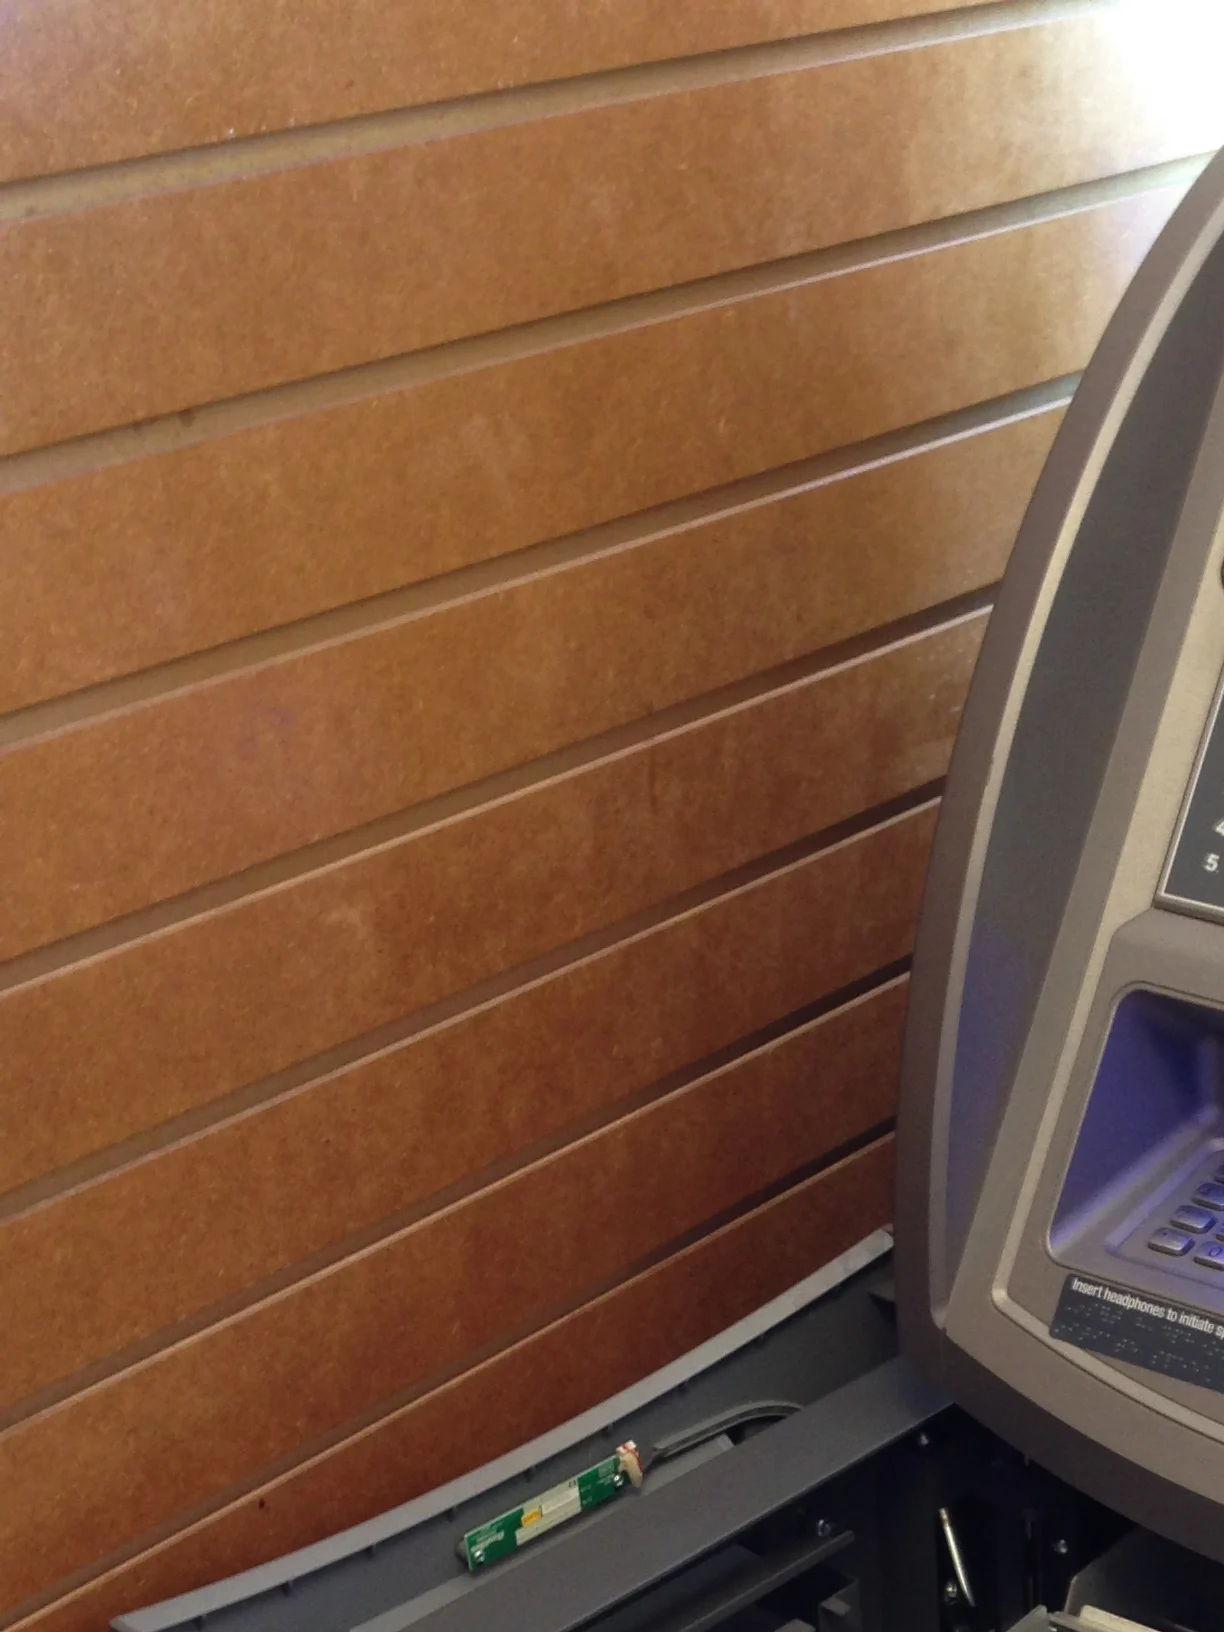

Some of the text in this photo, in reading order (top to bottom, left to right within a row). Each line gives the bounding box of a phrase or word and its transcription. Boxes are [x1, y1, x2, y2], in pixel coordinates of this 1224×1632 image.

[1071, 1278, 1104, 1298] Insert
[1103, 1286, 1165, 1319] headphones
[1167, 1307, 1179, 1322] to
[1179, 1310, 1215, 1334] initiate
